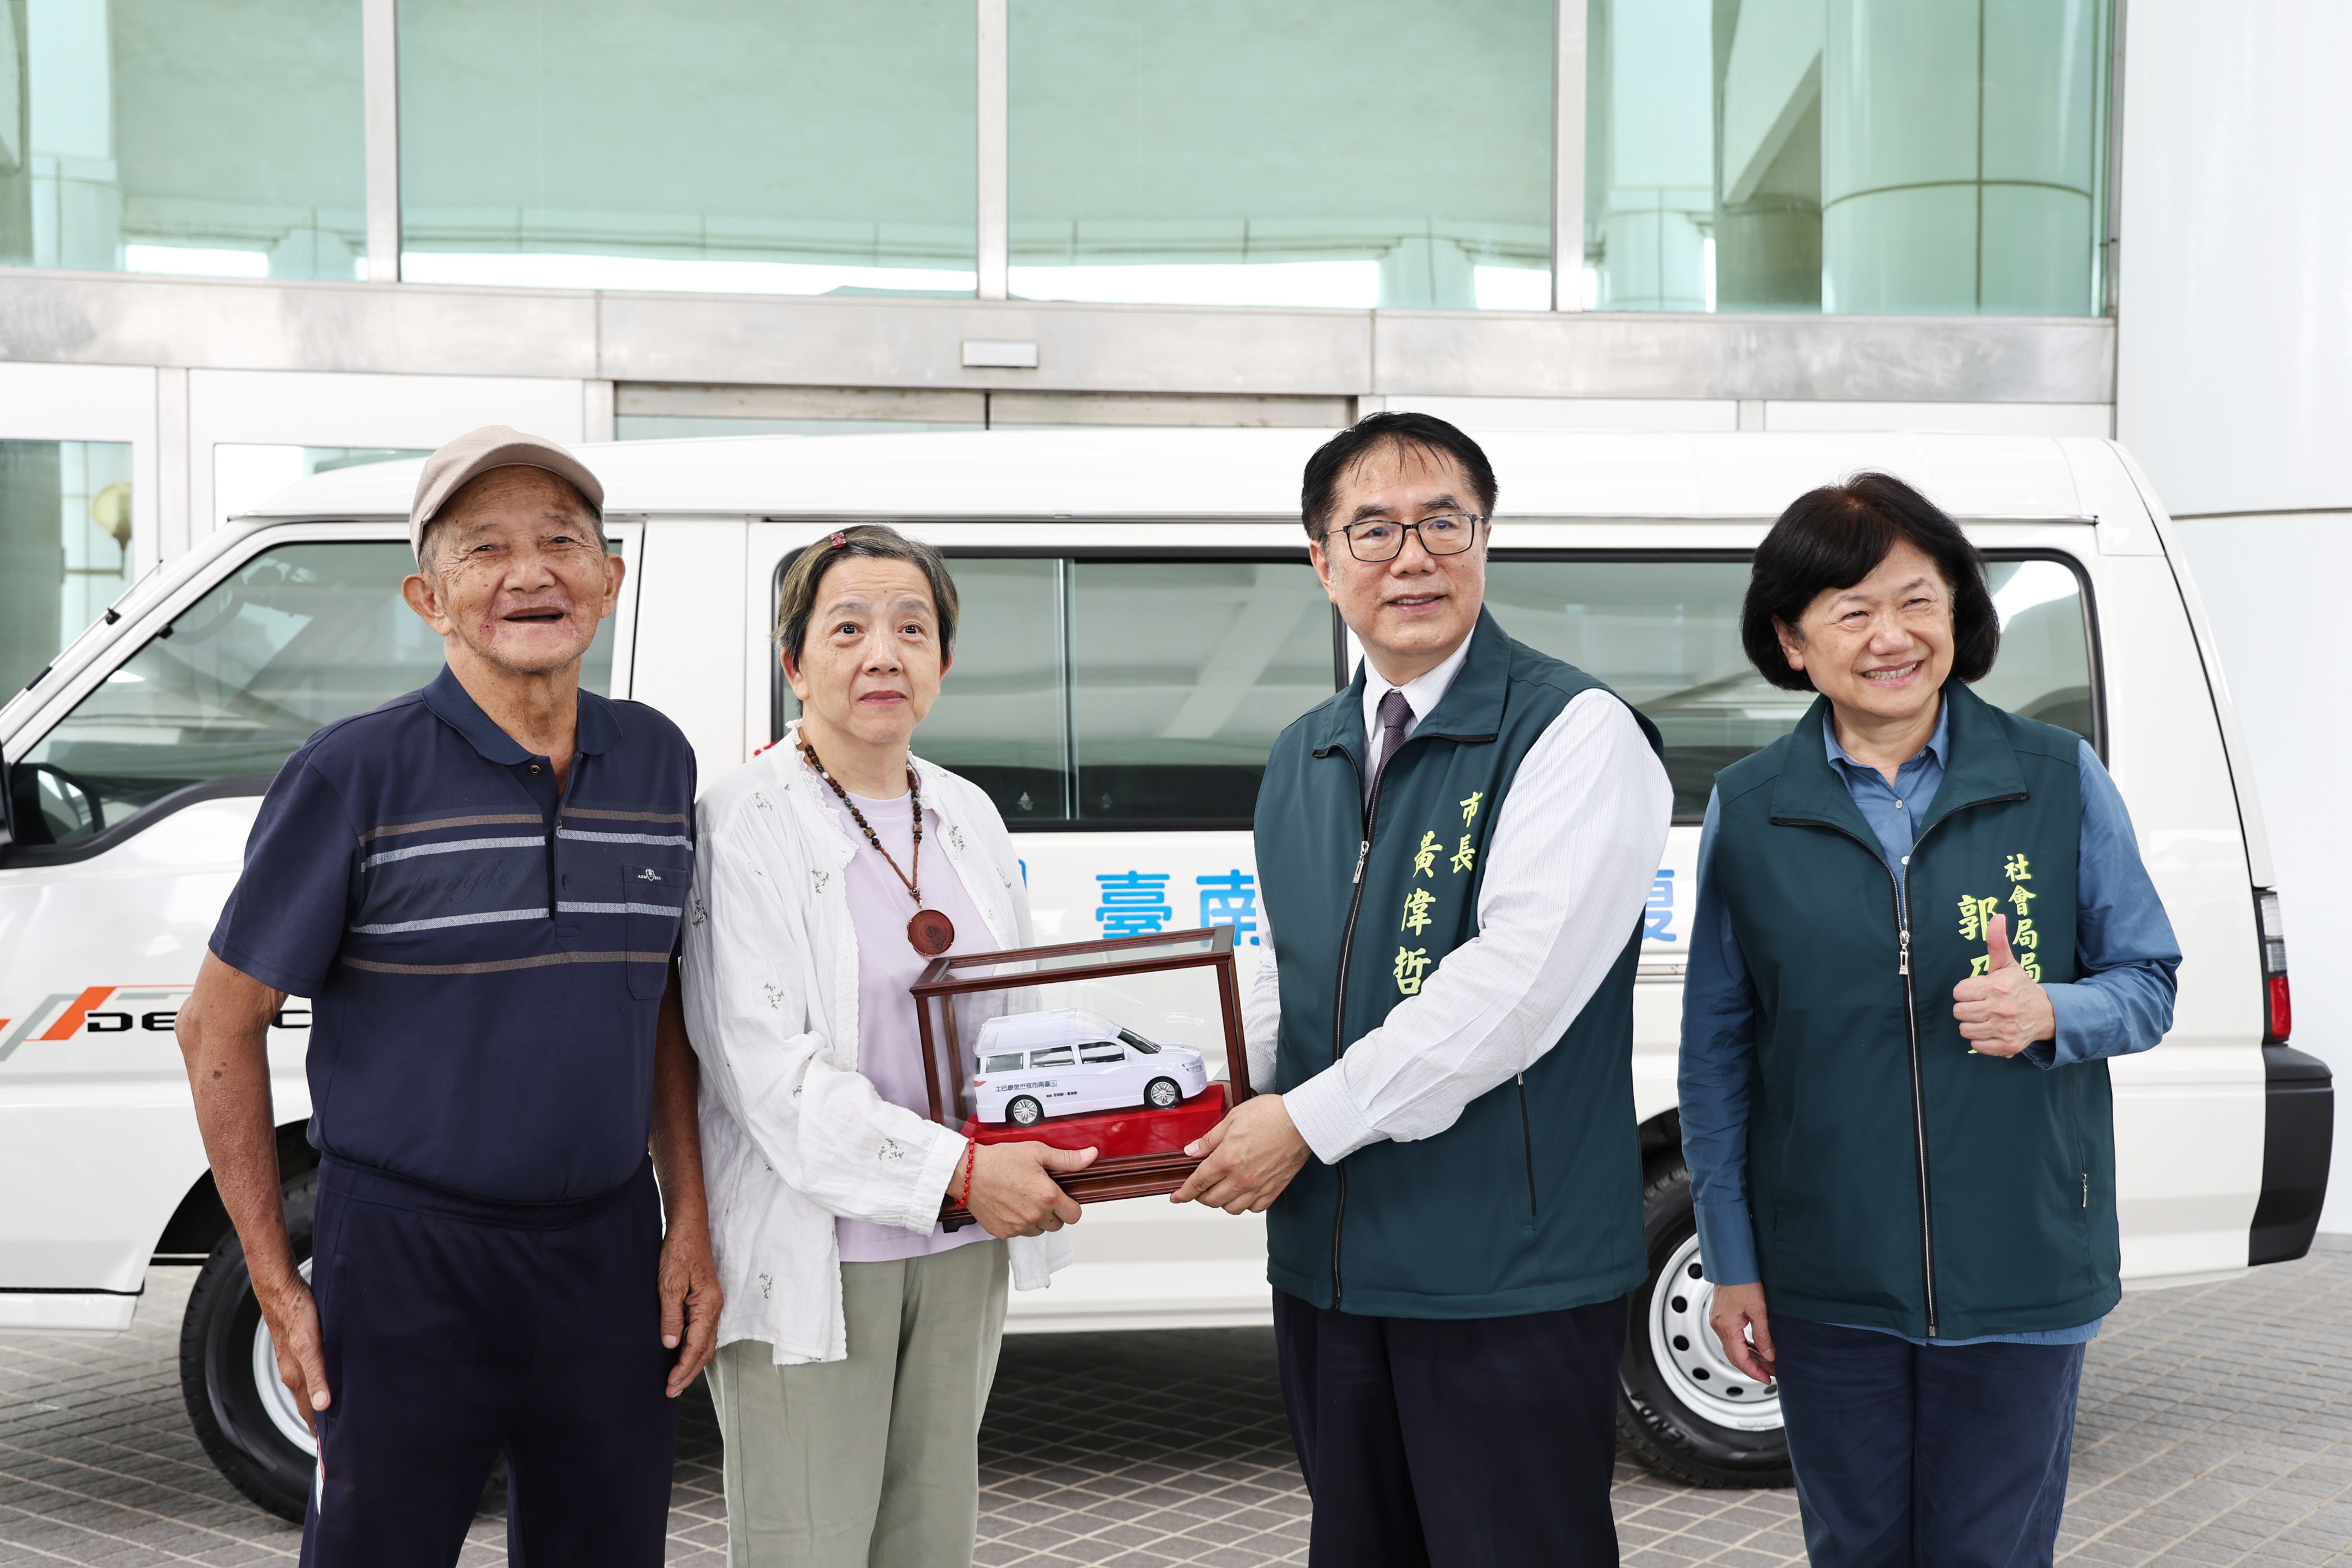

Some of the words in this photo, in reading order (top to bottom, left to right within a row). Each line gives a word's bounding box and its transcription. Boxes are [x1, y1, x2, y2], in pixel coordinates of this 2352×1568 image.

[1450, 791, 1483, 874] 市長
[1393, 830, 1443, 995] 黃偉哲
[1630, 1390, 1697, 1456] KENDA
